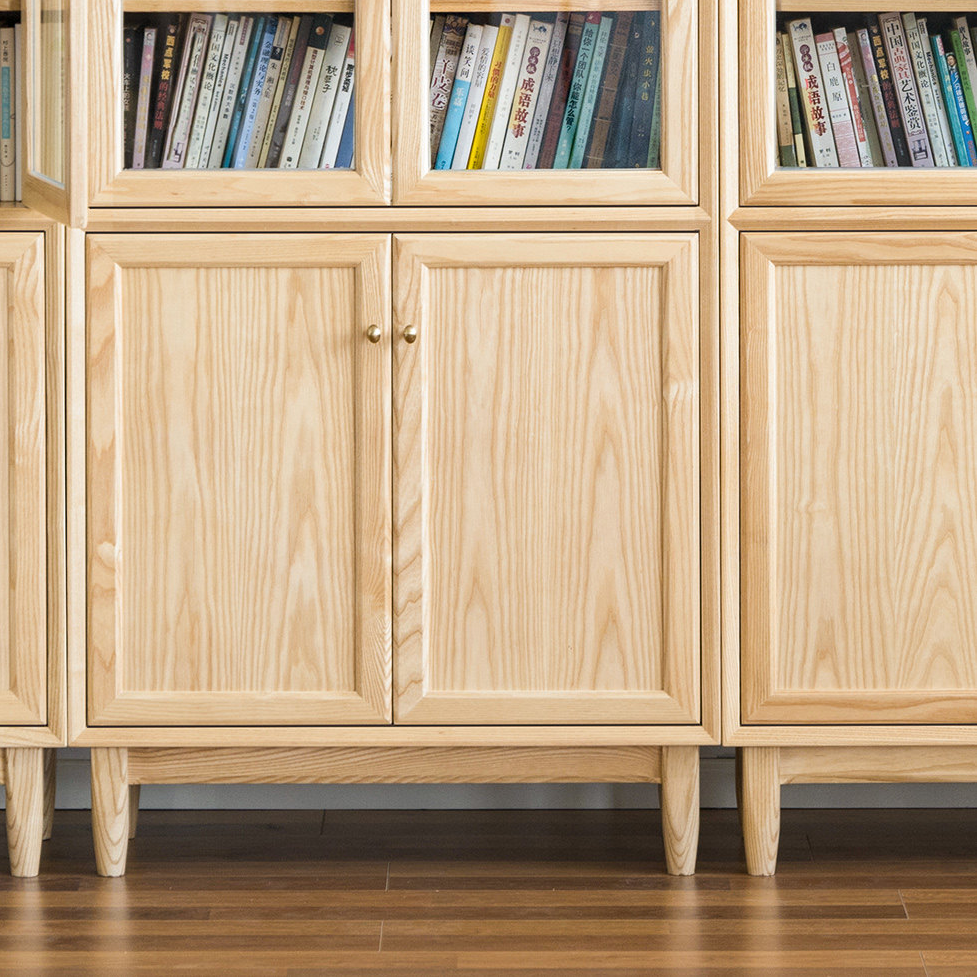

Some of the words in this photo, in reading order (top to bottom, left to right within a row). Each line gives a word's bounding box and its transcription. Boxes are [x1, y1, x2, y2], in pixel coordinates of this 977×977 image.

[203, 31, 223, 91] 中国文化概论
[431, 59, 455, 111] 羊皮卷
[460, 43, 476, 79] 谈笑间
[826, 61, 843, 102] 白鹿原
[886, 23, 922, 131] 中国古典家具艺术鉴赏
[908, 31, 930, 89] 中国文化概论
[511, 77, 536, 139] 成语故事
[805, 74, 828, 137] 成语故事
